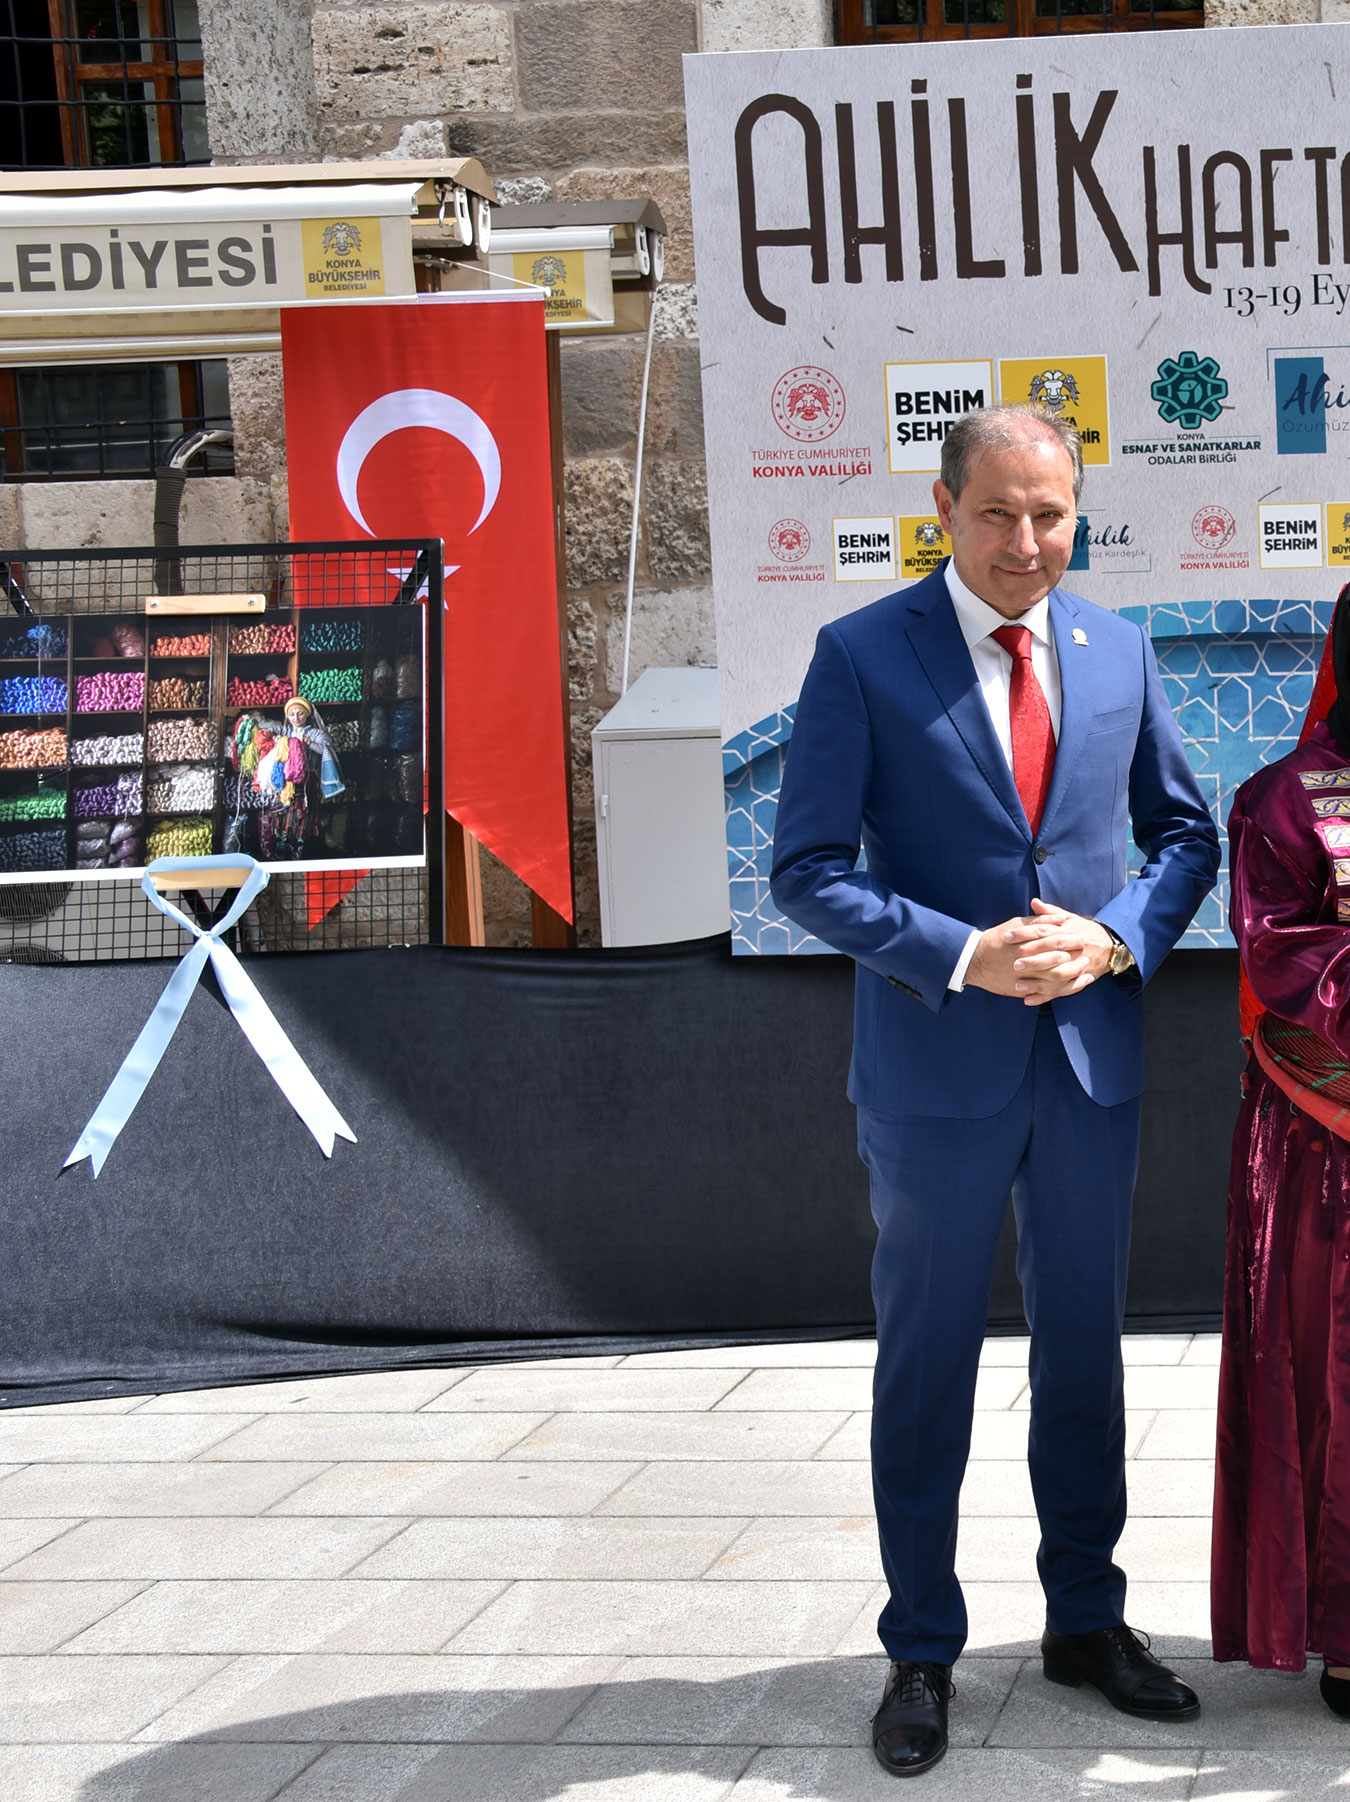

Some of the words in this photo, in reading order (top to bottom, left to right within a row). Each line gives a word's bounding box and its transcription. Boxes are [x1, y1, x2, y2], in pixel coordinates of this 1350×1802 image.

[734, 73, 1139, 326] AHİLİK
[326, 259, 362, 269] KONYA
[308, 268, 381, 283] BÜYÜKŞEHİR
[323, 283, 367, 292] BELEDİYESİ
[1223, 285, 1301, 317] 13-19
[1176, 433, 1206, 441] KONYA
[752, 448, 795, 460] TÜRKİYE
[797, 446, 871, 459] CUMHURİYETİ
[1122, 444, 1159, 454] ESNAF
[1161, 443, 1176, 453] VE
[1178, 441, 1261, 452] SANATKARLAR
[1148, 455, 1196, 465] ODALARI
[753, 465, 805, 478] KONYA
[808, 461, 872, 476] VALİLİĞİ
[1180, 562, 1211, 570] KONYA
[1212, 560, 1250, 569] VALİLİĞİ
[758, 574, 787, 582] KONYA
